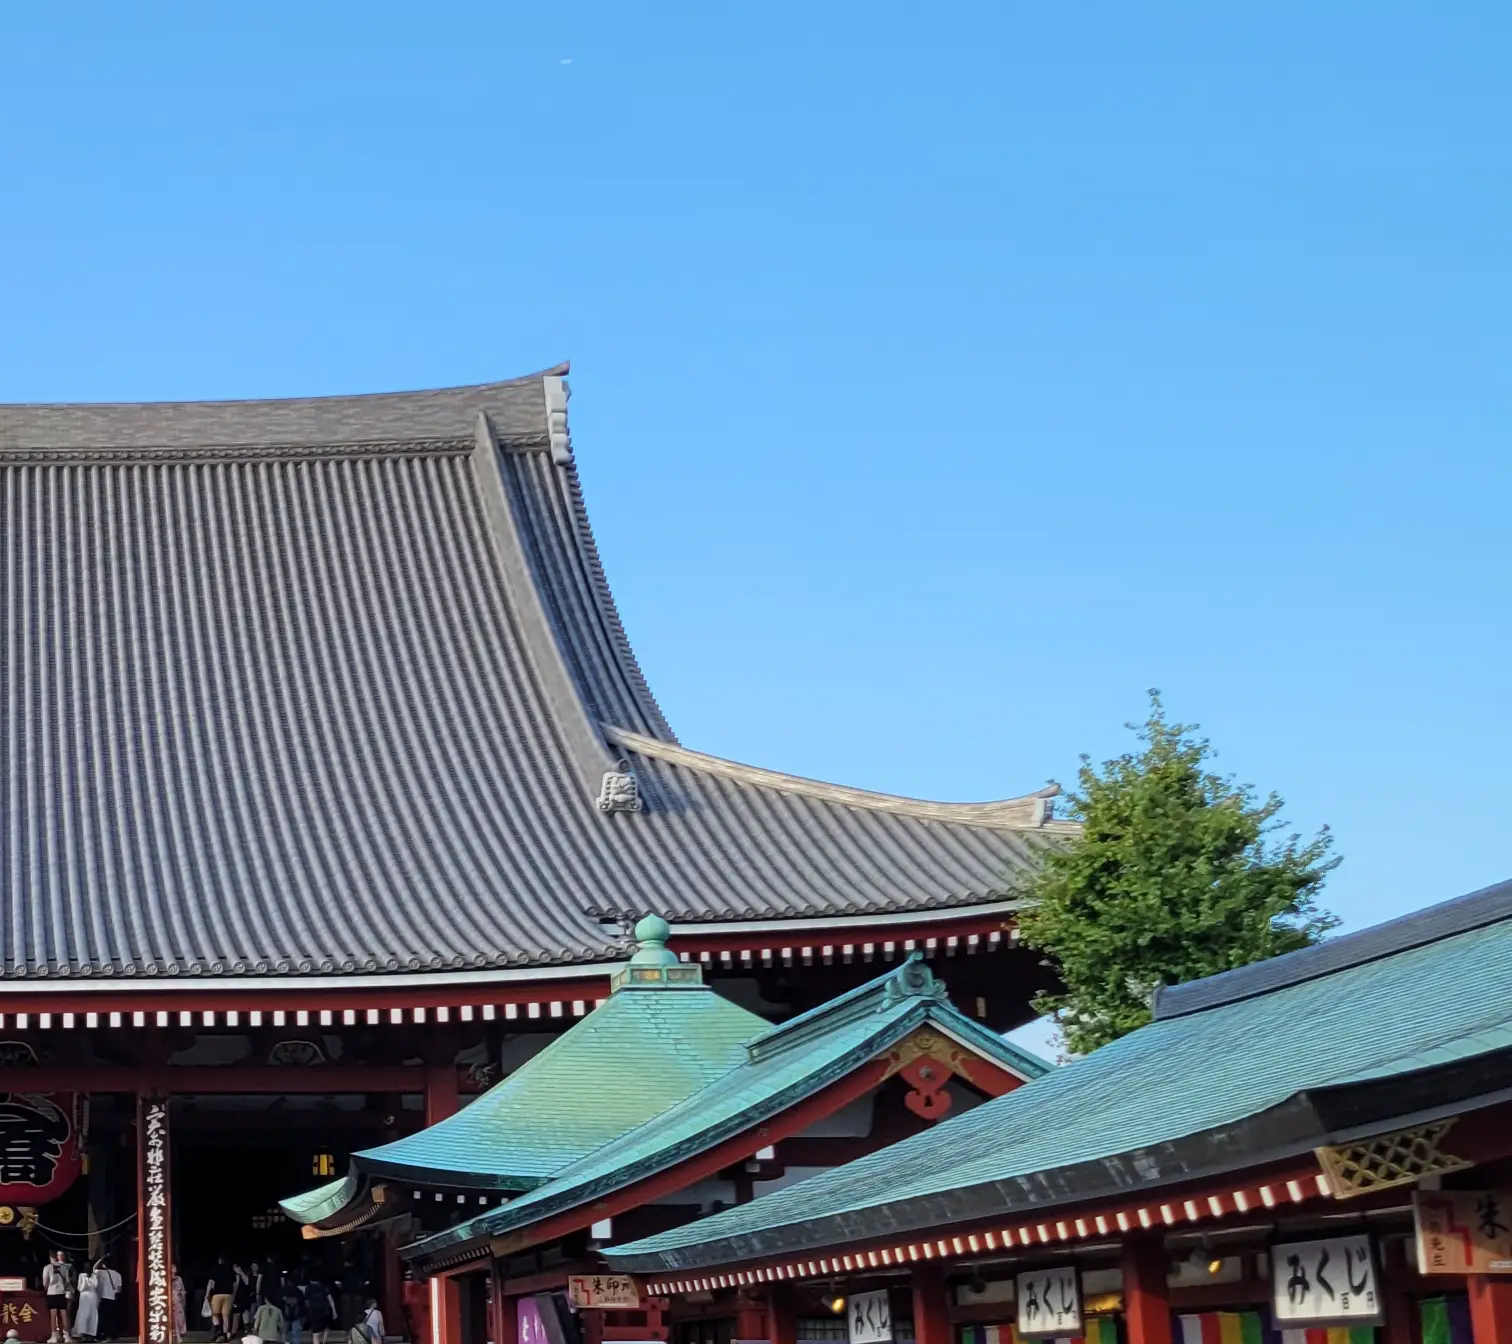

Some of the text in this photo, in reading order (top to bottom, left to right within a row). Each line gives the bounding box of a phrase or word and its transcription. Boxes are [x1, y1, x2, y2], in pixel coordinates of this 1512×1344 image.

[1025, 1277, 1073, 1320] みくじ
[1287, 1245, 1368, 1306] みくじ
